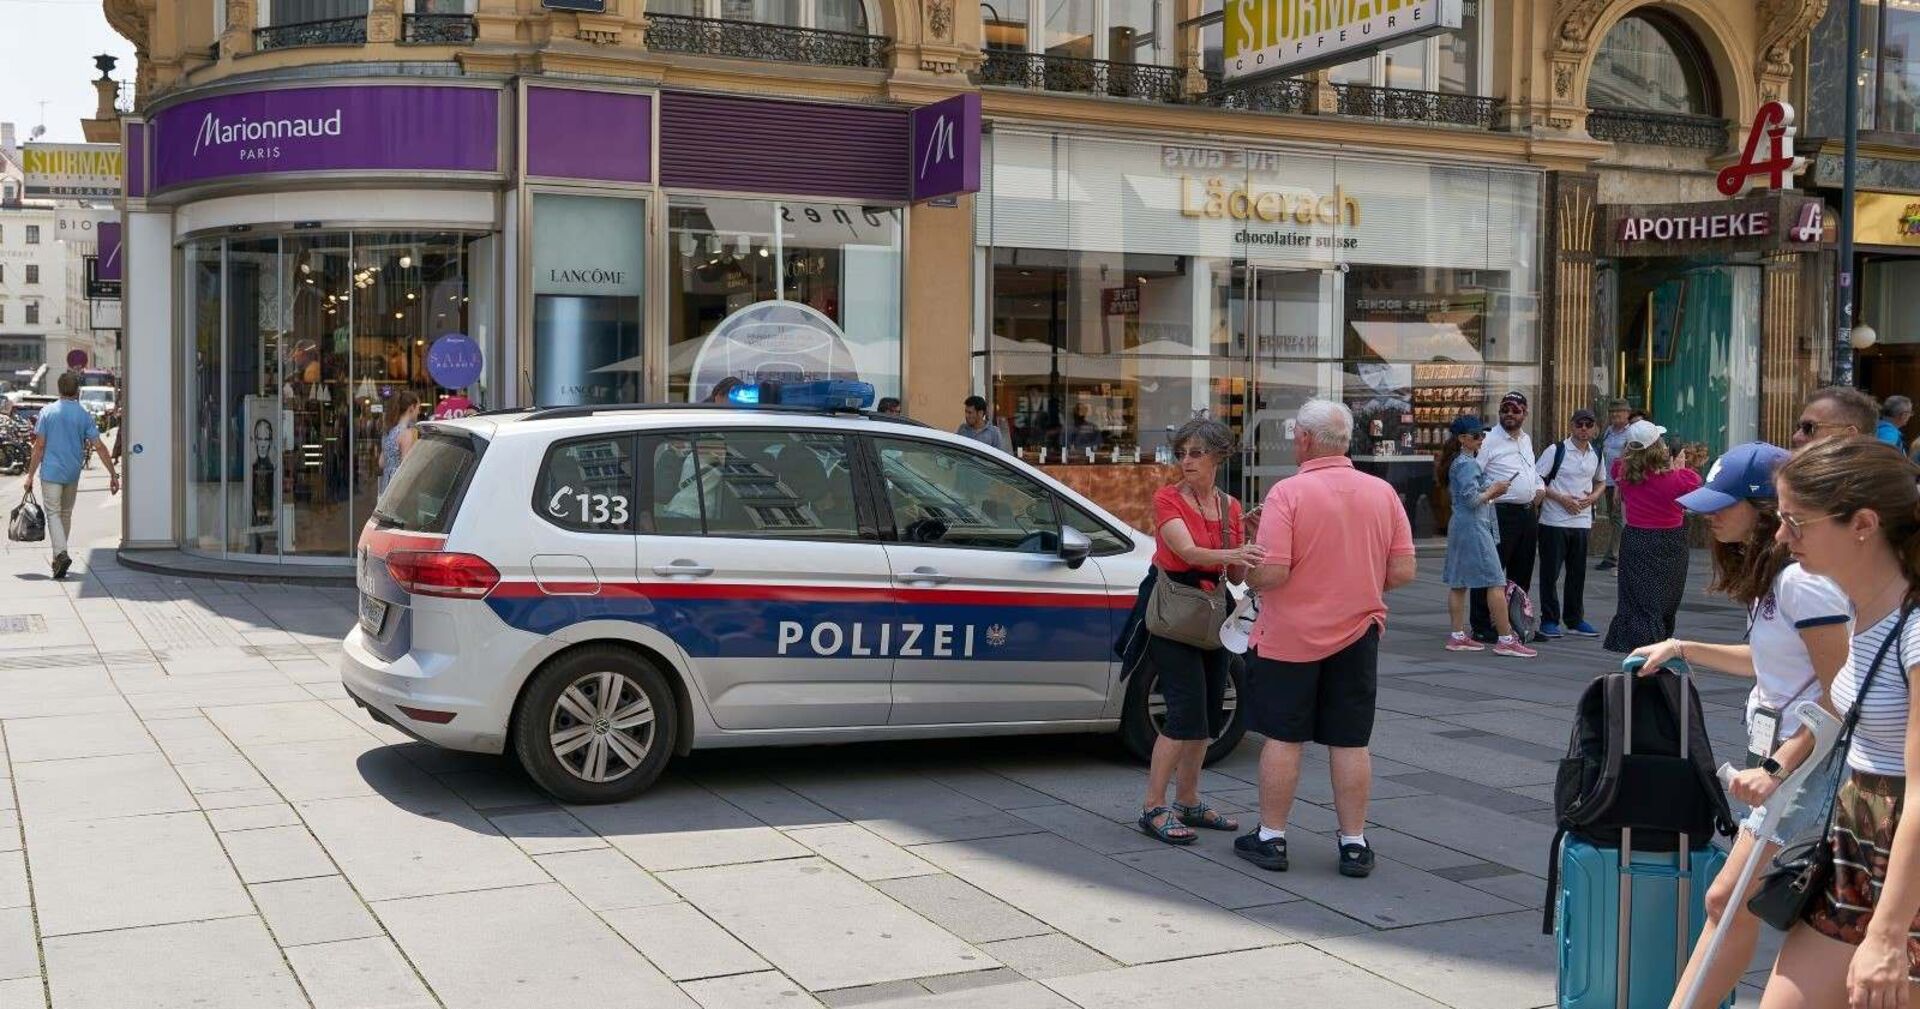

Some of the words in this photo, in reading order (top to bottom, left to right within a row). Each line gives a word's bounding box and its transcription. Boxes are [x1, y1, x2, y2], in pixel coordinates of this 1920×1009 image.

[1236, 8, 1422, 70] COIFFEURE
[194, 108, 341, 156] Marionnaud
[240, 146, 281, 160] PARIS
[49, 187, 115, 195] EINGANG
[1181, 174, 1361, 226] Läderach
[1234, 229, 1311, 247] chocolatier
[1315, 236, 1359, 249] suisse
[1624, 211, 1764, 240] APOTHEKE
[576, 494, 629, 524] 133
[778, 621, 974, 656] POLIZEI
